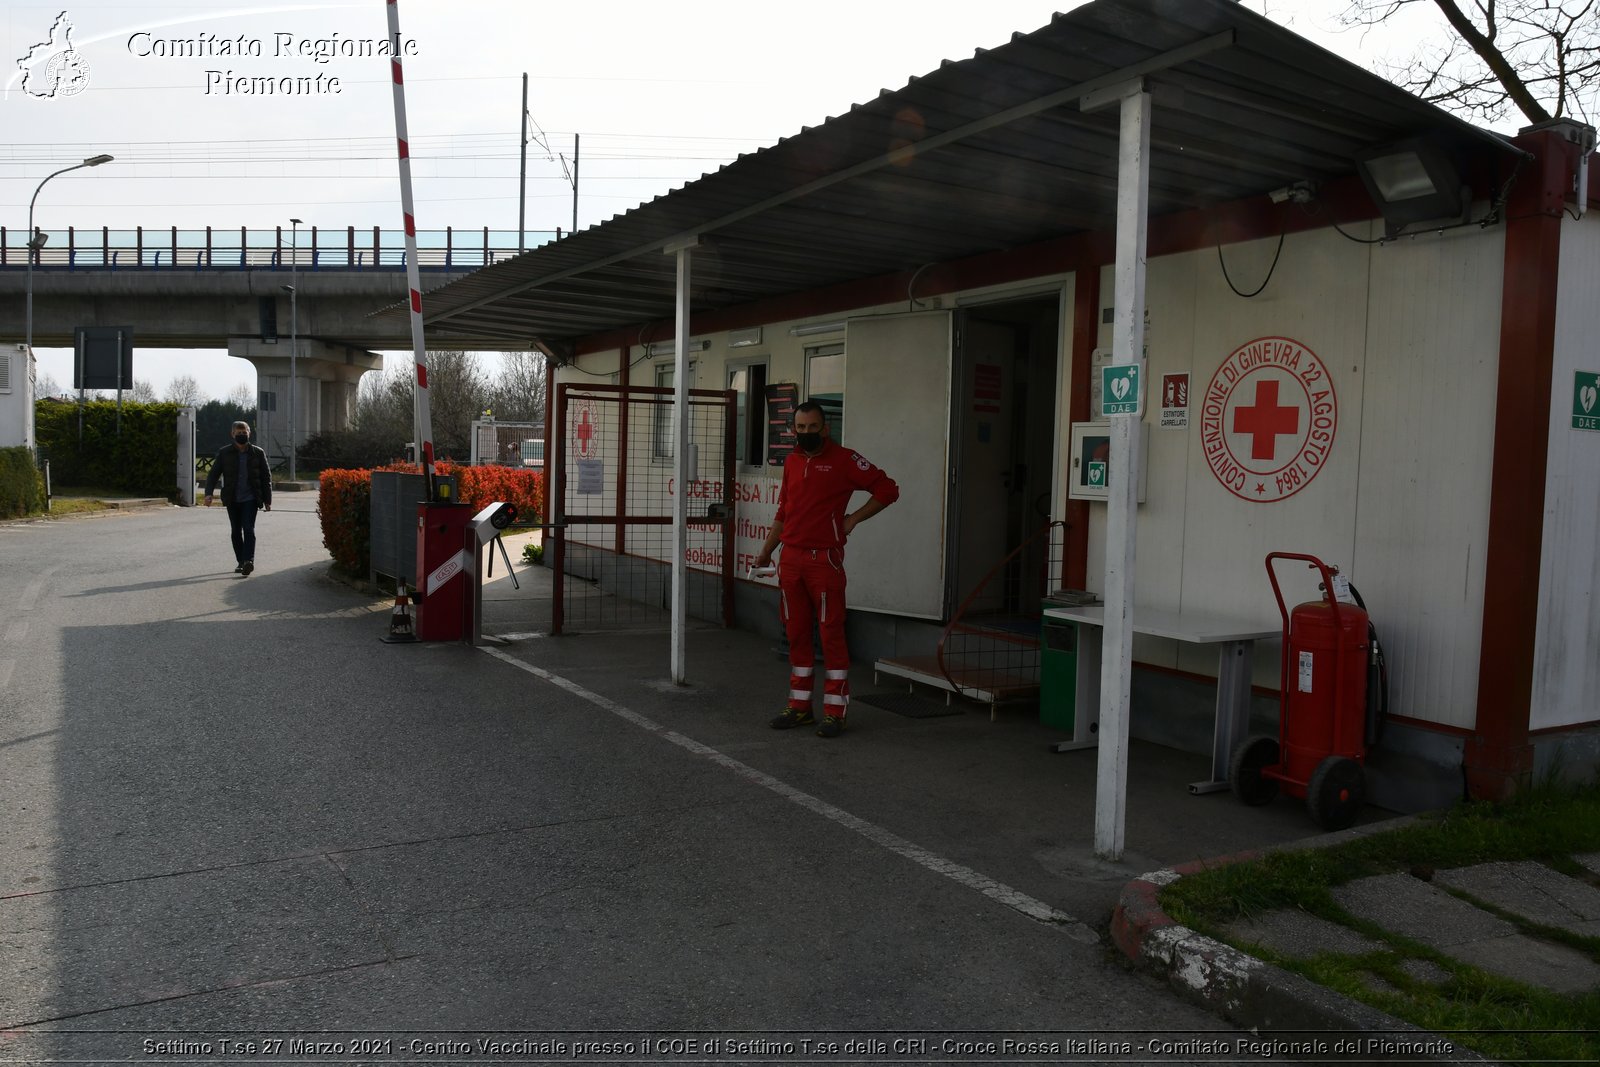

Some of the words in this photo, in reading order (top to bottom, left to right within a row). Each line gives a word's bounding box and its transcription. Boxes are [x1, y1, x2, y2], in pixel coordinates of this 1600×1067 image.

[1238, 342, 1302, 371] GINEVRA
[1222, 361, 1240, 384] DI
[1301, 362, 1321, 387] 22
[1110, 403, 1131, 413] DAE
[1163, 410, 1186, 418] ESTINTORE
[1205, 380, 1246, 491] CONVENZIONE
[1303, 390, 1333, 466] AGOSTO
[1578, 417, 1597, 429] DAE
[1275, 462, 1308, 495] 1864
